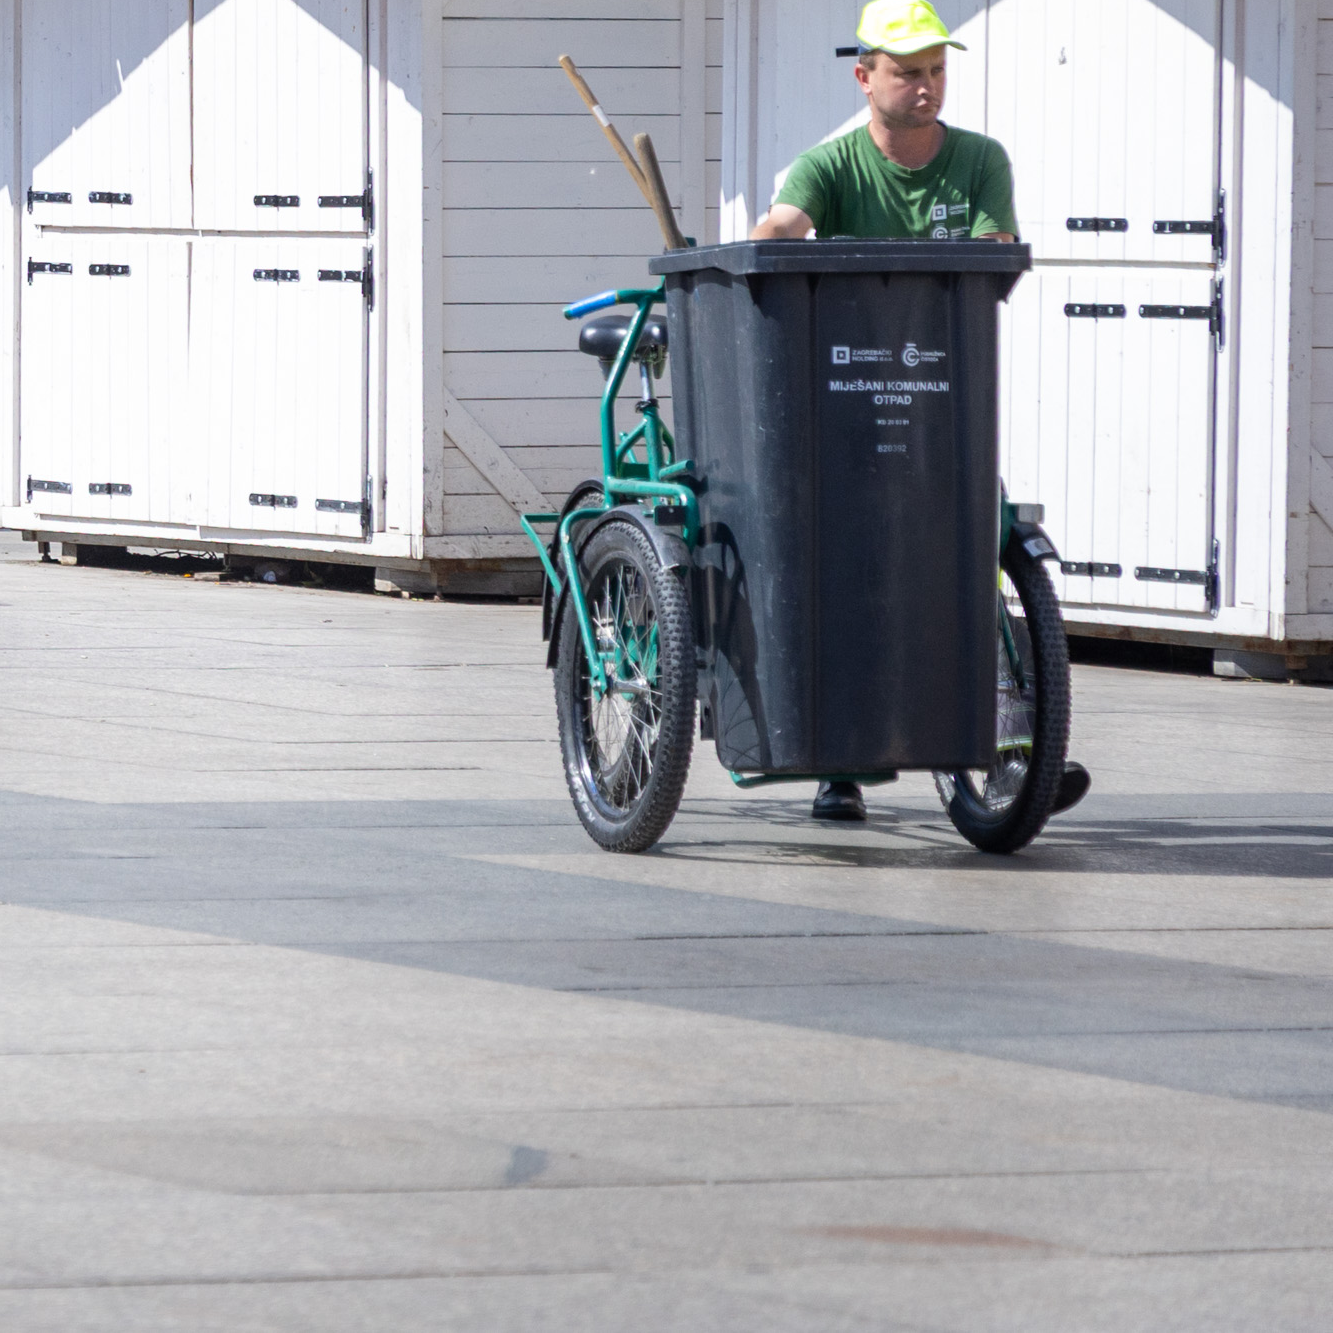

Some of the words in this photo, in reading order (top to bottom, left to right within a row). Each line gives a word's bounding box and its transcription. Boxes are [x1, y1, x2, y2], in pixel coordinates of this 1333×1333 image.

[830, 380, 884, 391] MIJEŠANI
[887, 381, 949, 391] KOMUNALNI
[874, 395, 912, 405] OTPAD
